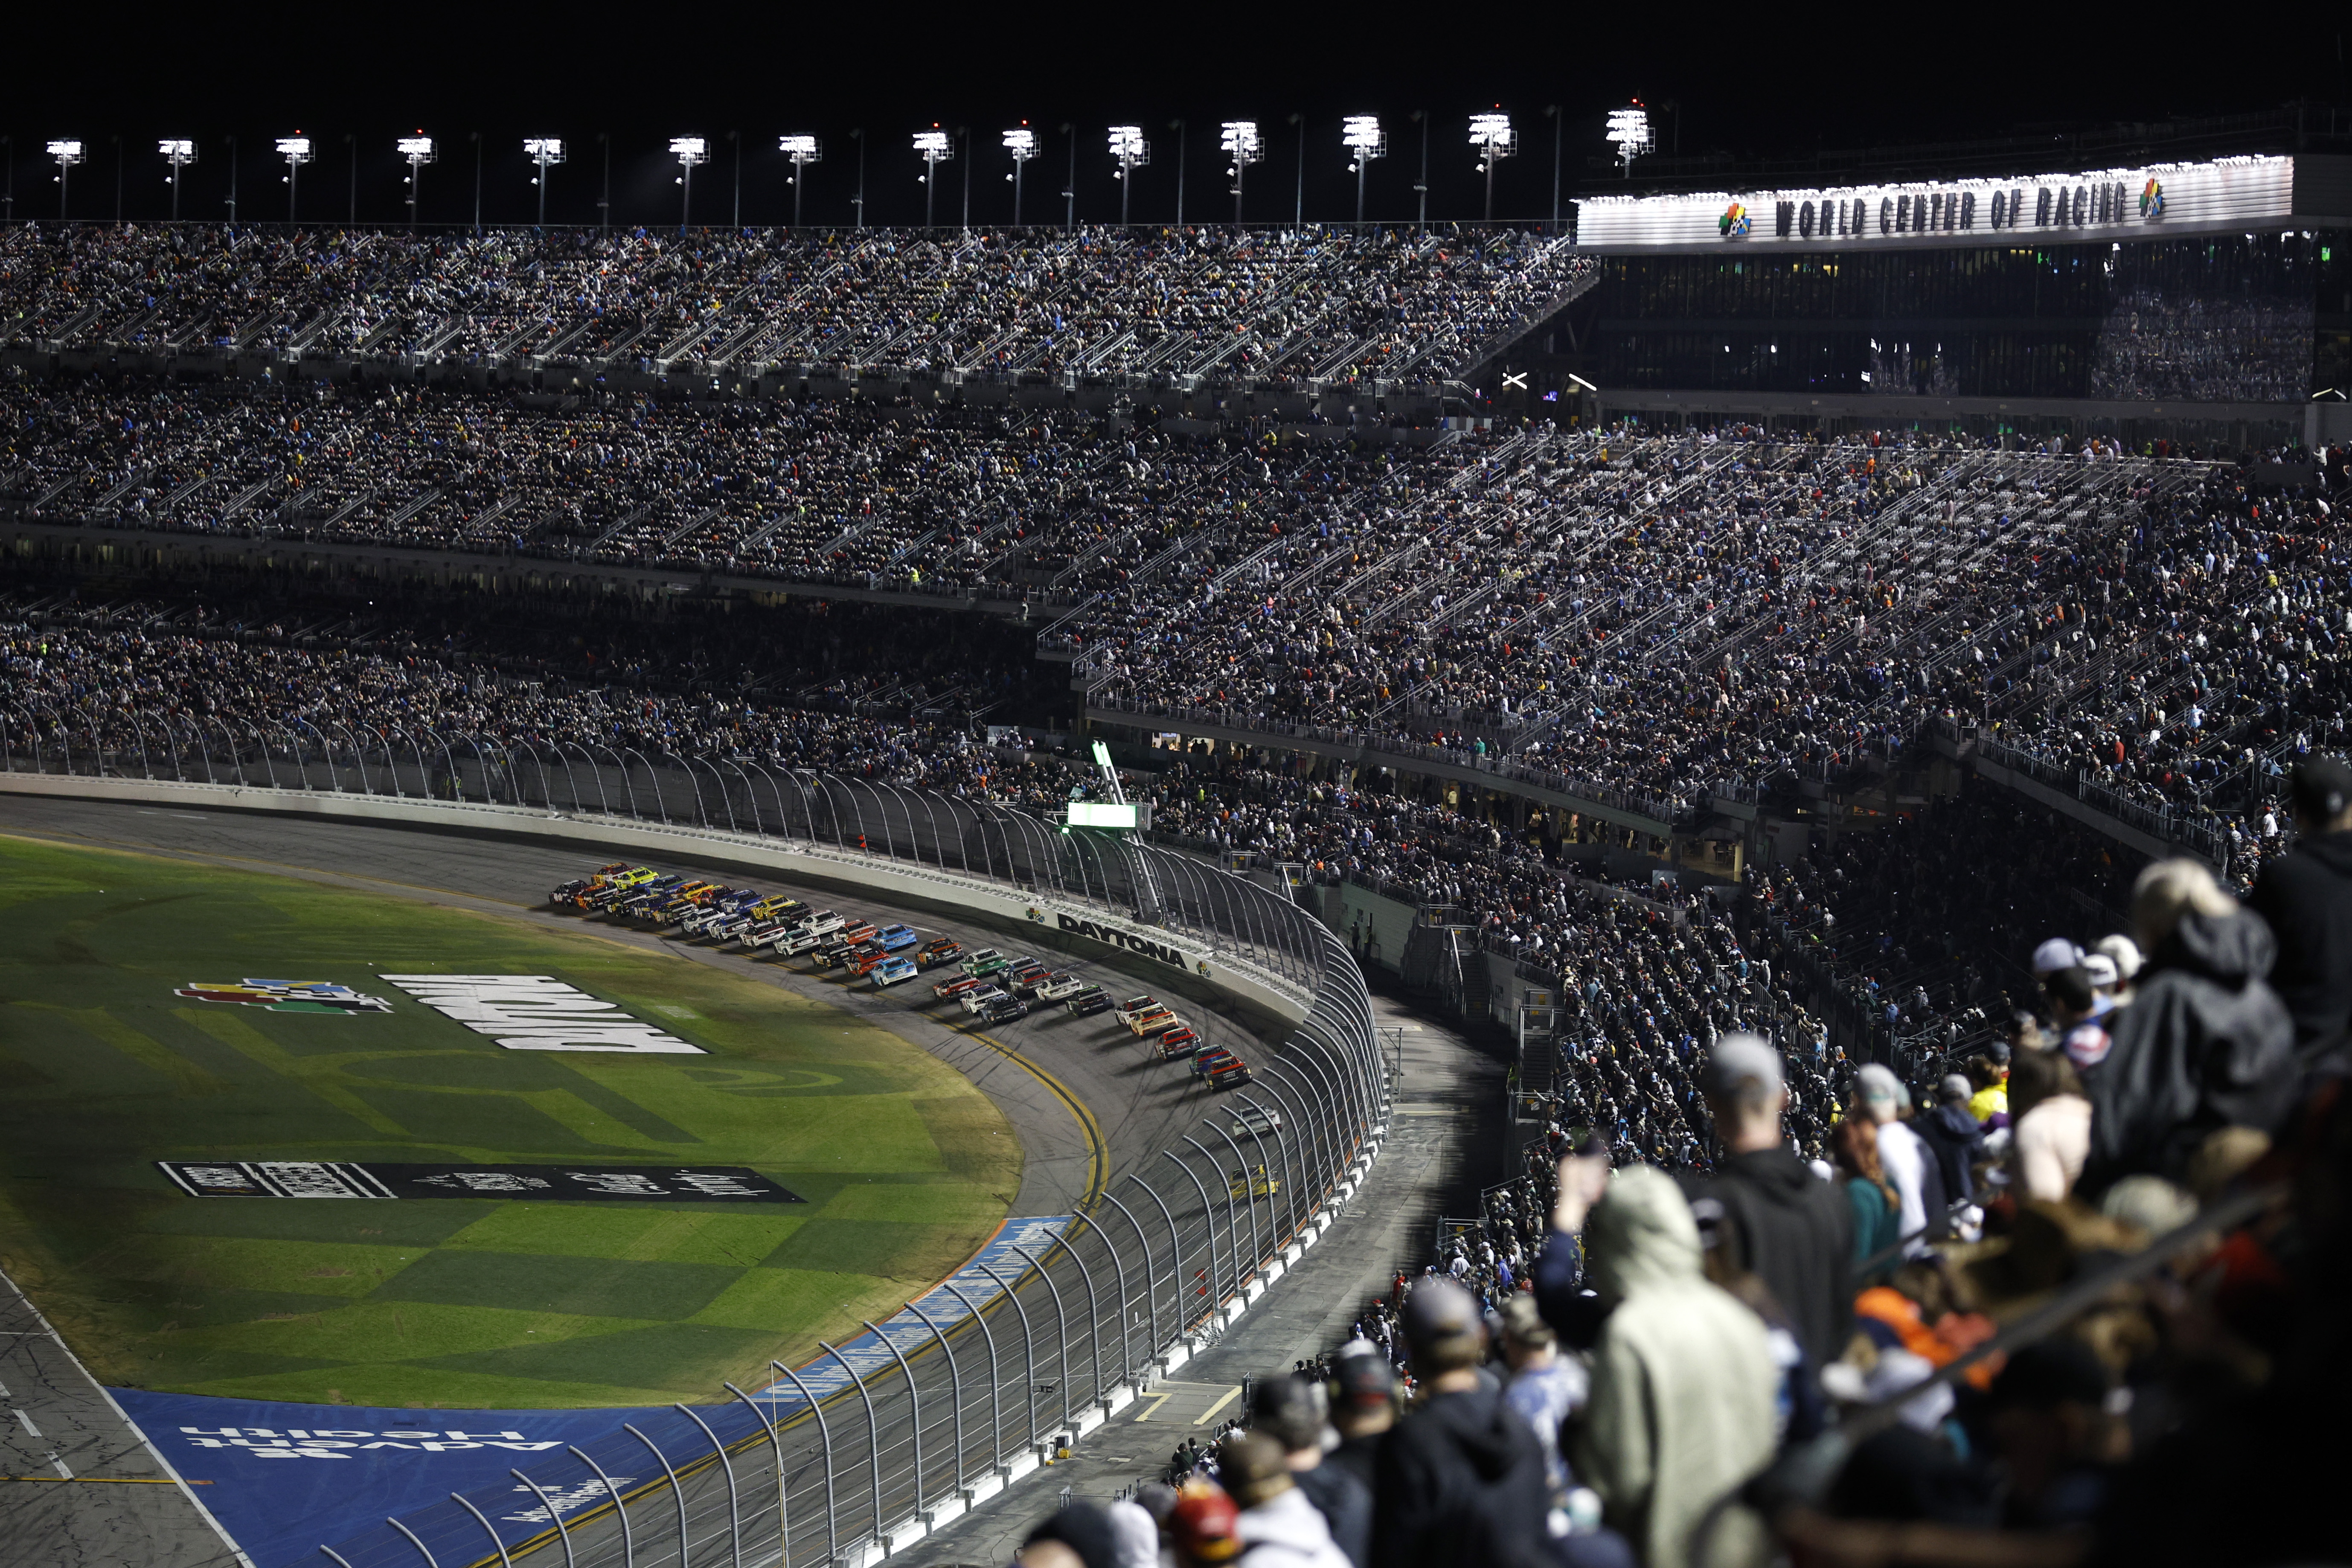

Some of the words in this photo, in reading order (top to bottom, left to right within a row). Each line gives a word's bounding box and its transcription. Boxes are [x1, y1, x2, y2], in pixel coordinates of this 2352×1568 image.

[1776, 198, 1864, 237] WORLD
[1880, 192, 1973, 234] CENTER
[1991, 189, 2021, 229] OF
[2035, 181, 2124, 226] RACING
[1058, 913, 1188, 970] DAYTONA
